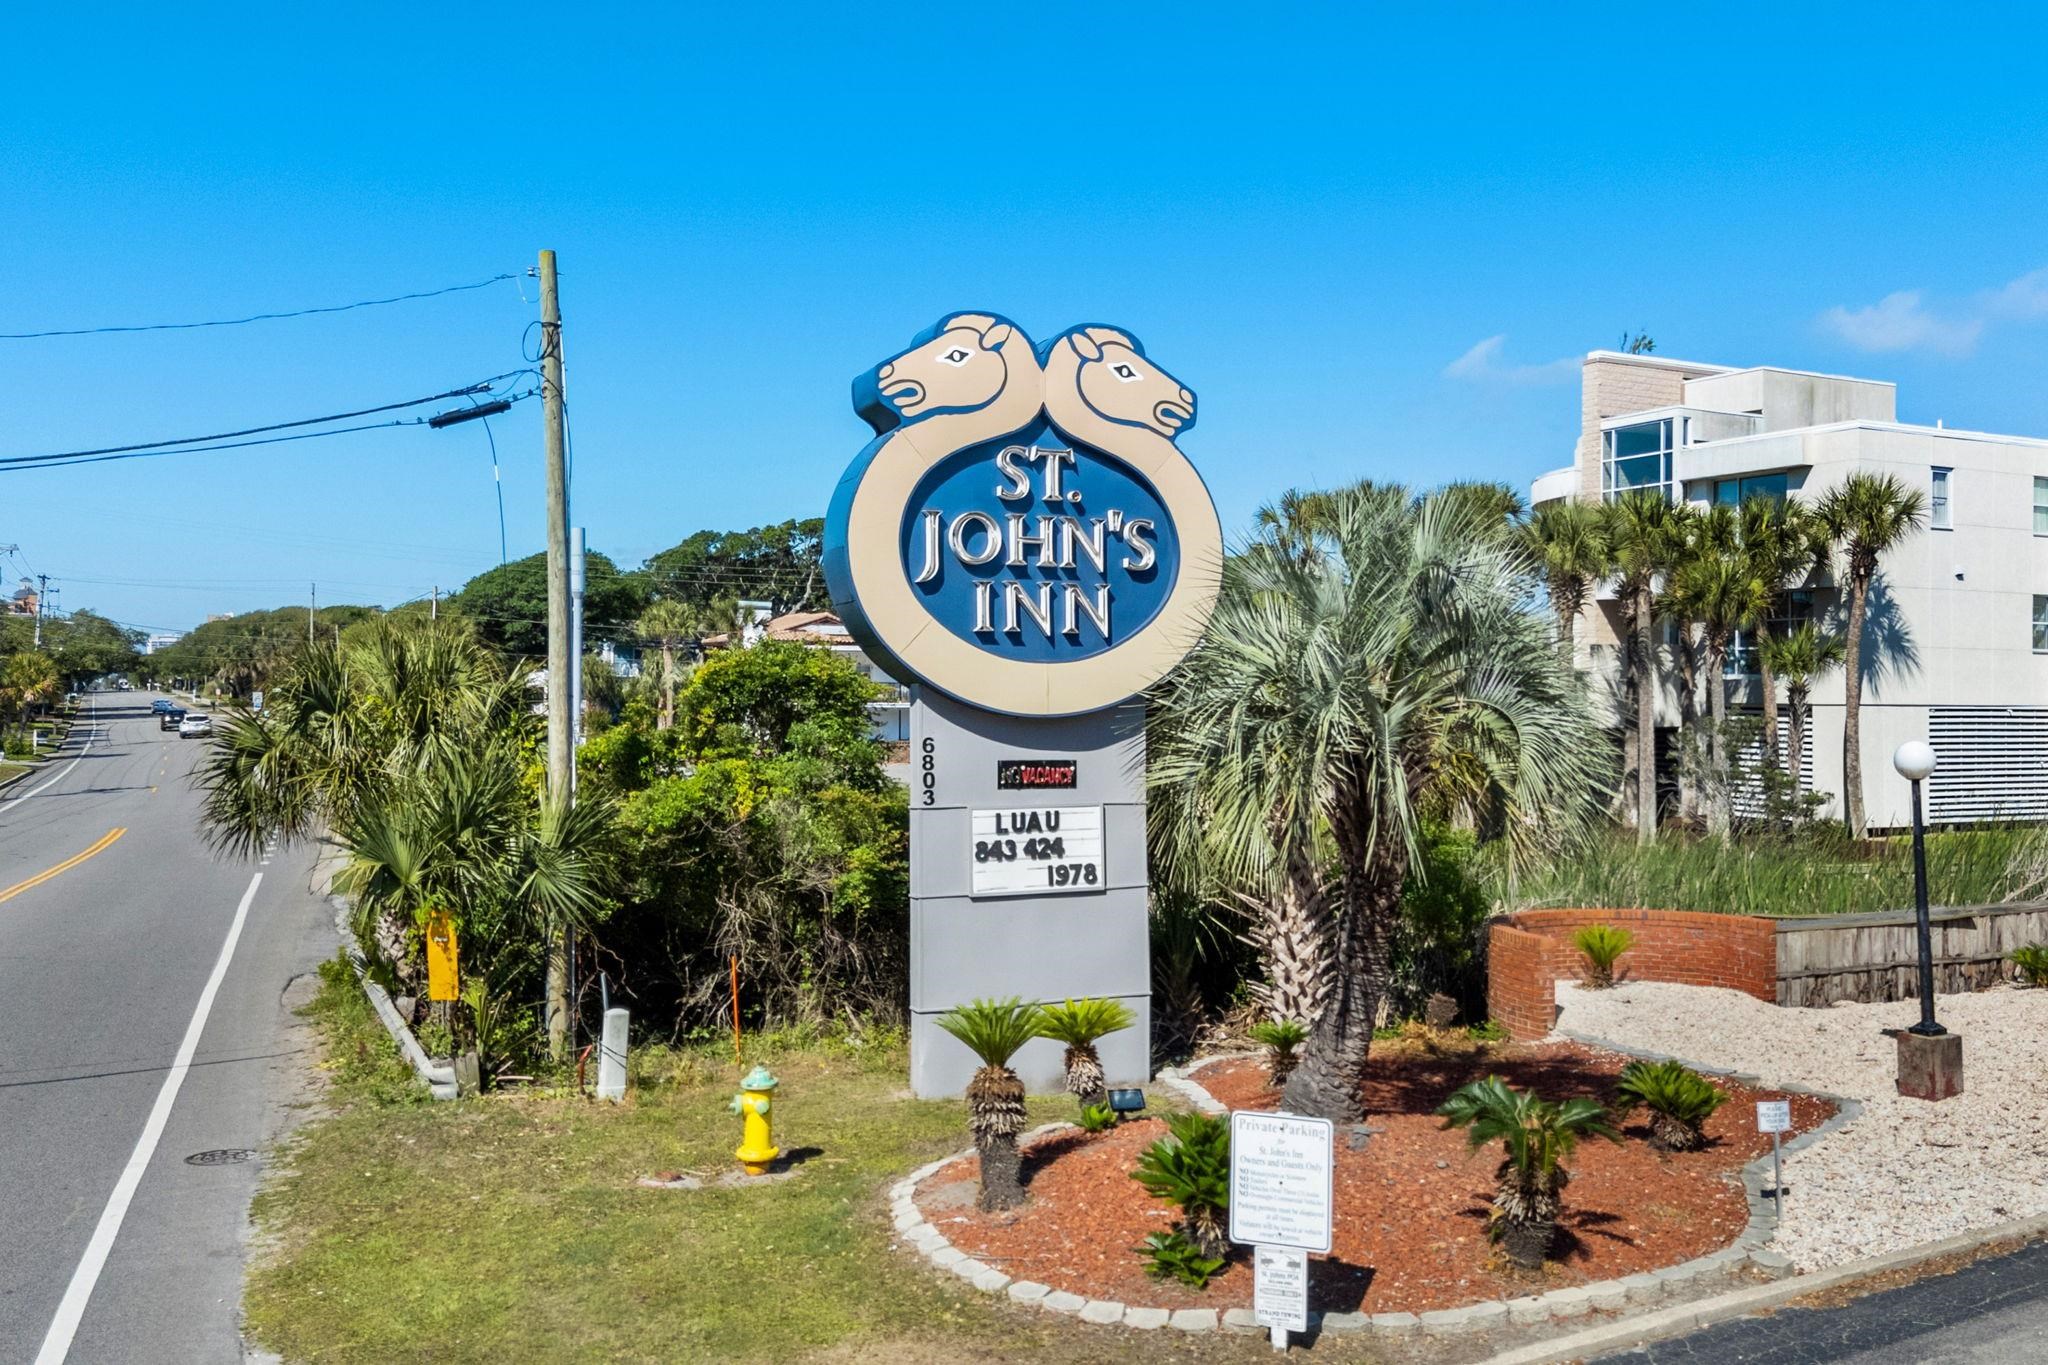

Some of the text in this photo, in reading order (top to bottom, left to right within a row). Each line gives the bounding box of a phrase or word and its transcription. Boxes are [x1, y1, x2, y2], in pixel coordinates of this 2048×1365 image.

[996, 445, 1082, 503] ST.
[915, 509, 1156, 583] JOHN'S
[973, 580, 1111, 638] INN
[922, 737, 935, 806] 6803
[1000, 765, 1075, 785] NO VACANCY
[995, 810, 1060, 835] LUAU
[975, 837, 1065, 863] 843 424
[1048, 863, 1098, 887] 1978
[1239, 1118, 1326, 1143] Private Parking
[1239, 1155, 1322, 1174] Owners and Guests Only
[1293, 1149, 1303, 1159] Inn
